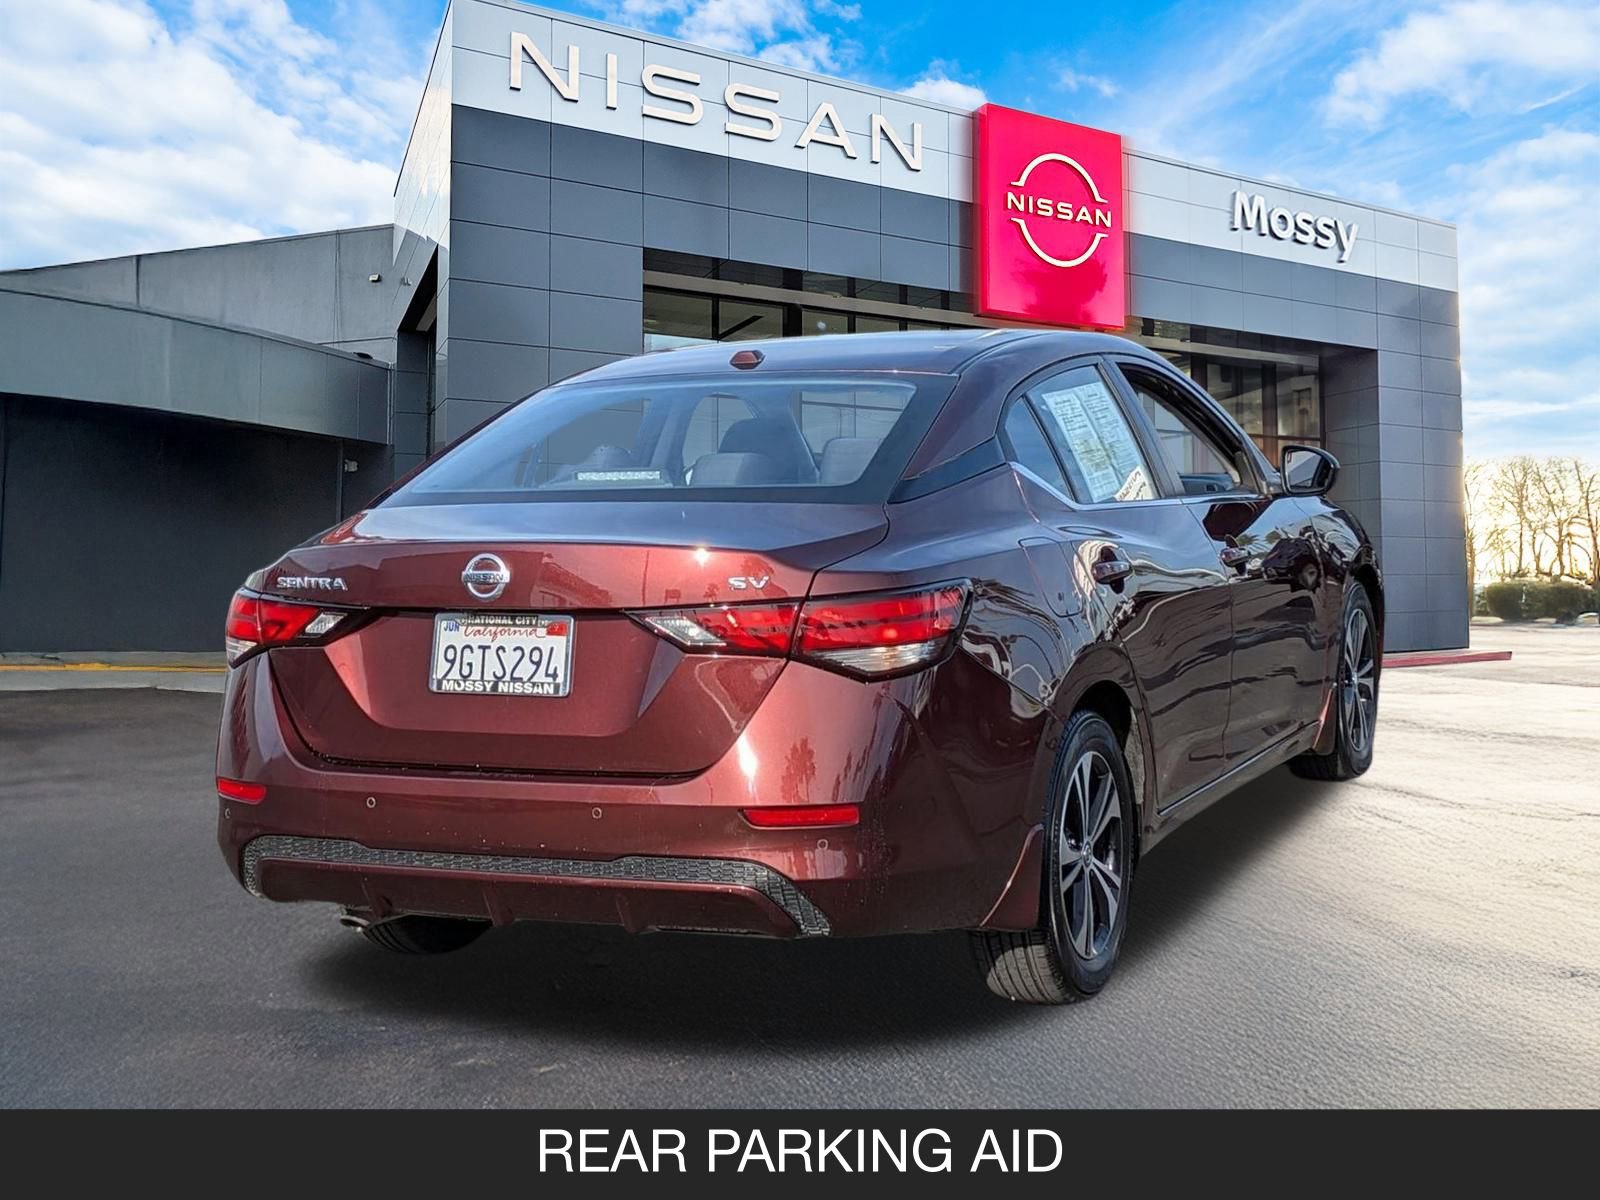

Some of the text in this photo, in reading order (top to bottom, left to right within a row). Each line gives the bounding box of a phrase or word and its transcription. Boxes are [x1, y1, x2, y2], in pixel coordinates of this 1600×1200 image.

[509, 31, 923, 172] NISSAN
[1006, 191, 1112, 228] NISSAN
[1230, 190, 1359, 263] Mossy
[276, 576, 348, 591] SENTRA
[464, 573, 504, 582] NISSAN
[727, 575, 770, 589] SV
[443, 620, 460, 632] JUN
[468, 615, 538, 625] NATIONAL CITY
[464, 624, 546, 642] California
[442, 644, 558, 682] 9GTS294
[442, 681, 554, 694] MOSSY NISSAN
